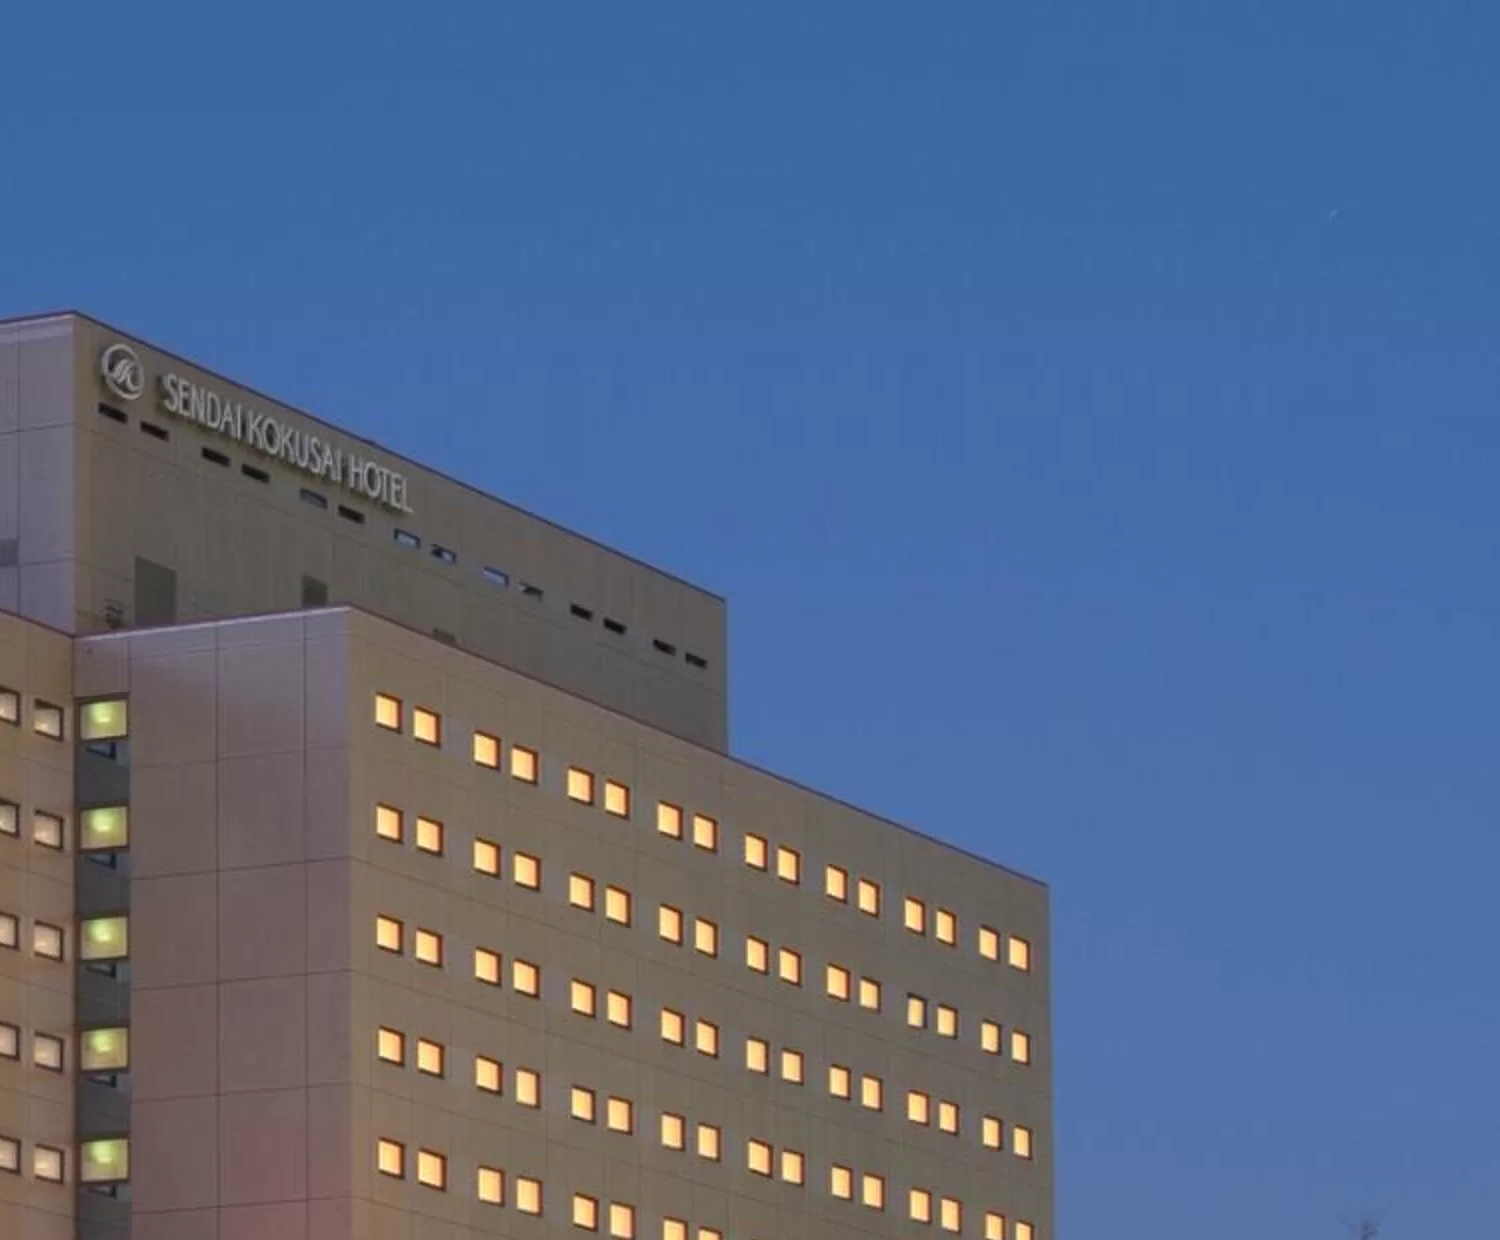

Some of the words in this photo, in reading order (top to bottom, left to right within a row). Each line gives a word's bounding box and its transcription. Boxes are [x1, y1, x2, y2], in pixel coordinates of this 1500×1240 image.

[162, 372, 242, 440] SENDAI
[247, 408, 342, 482] KOKUSAI
[348, 453, 414, 513] HOTEL
